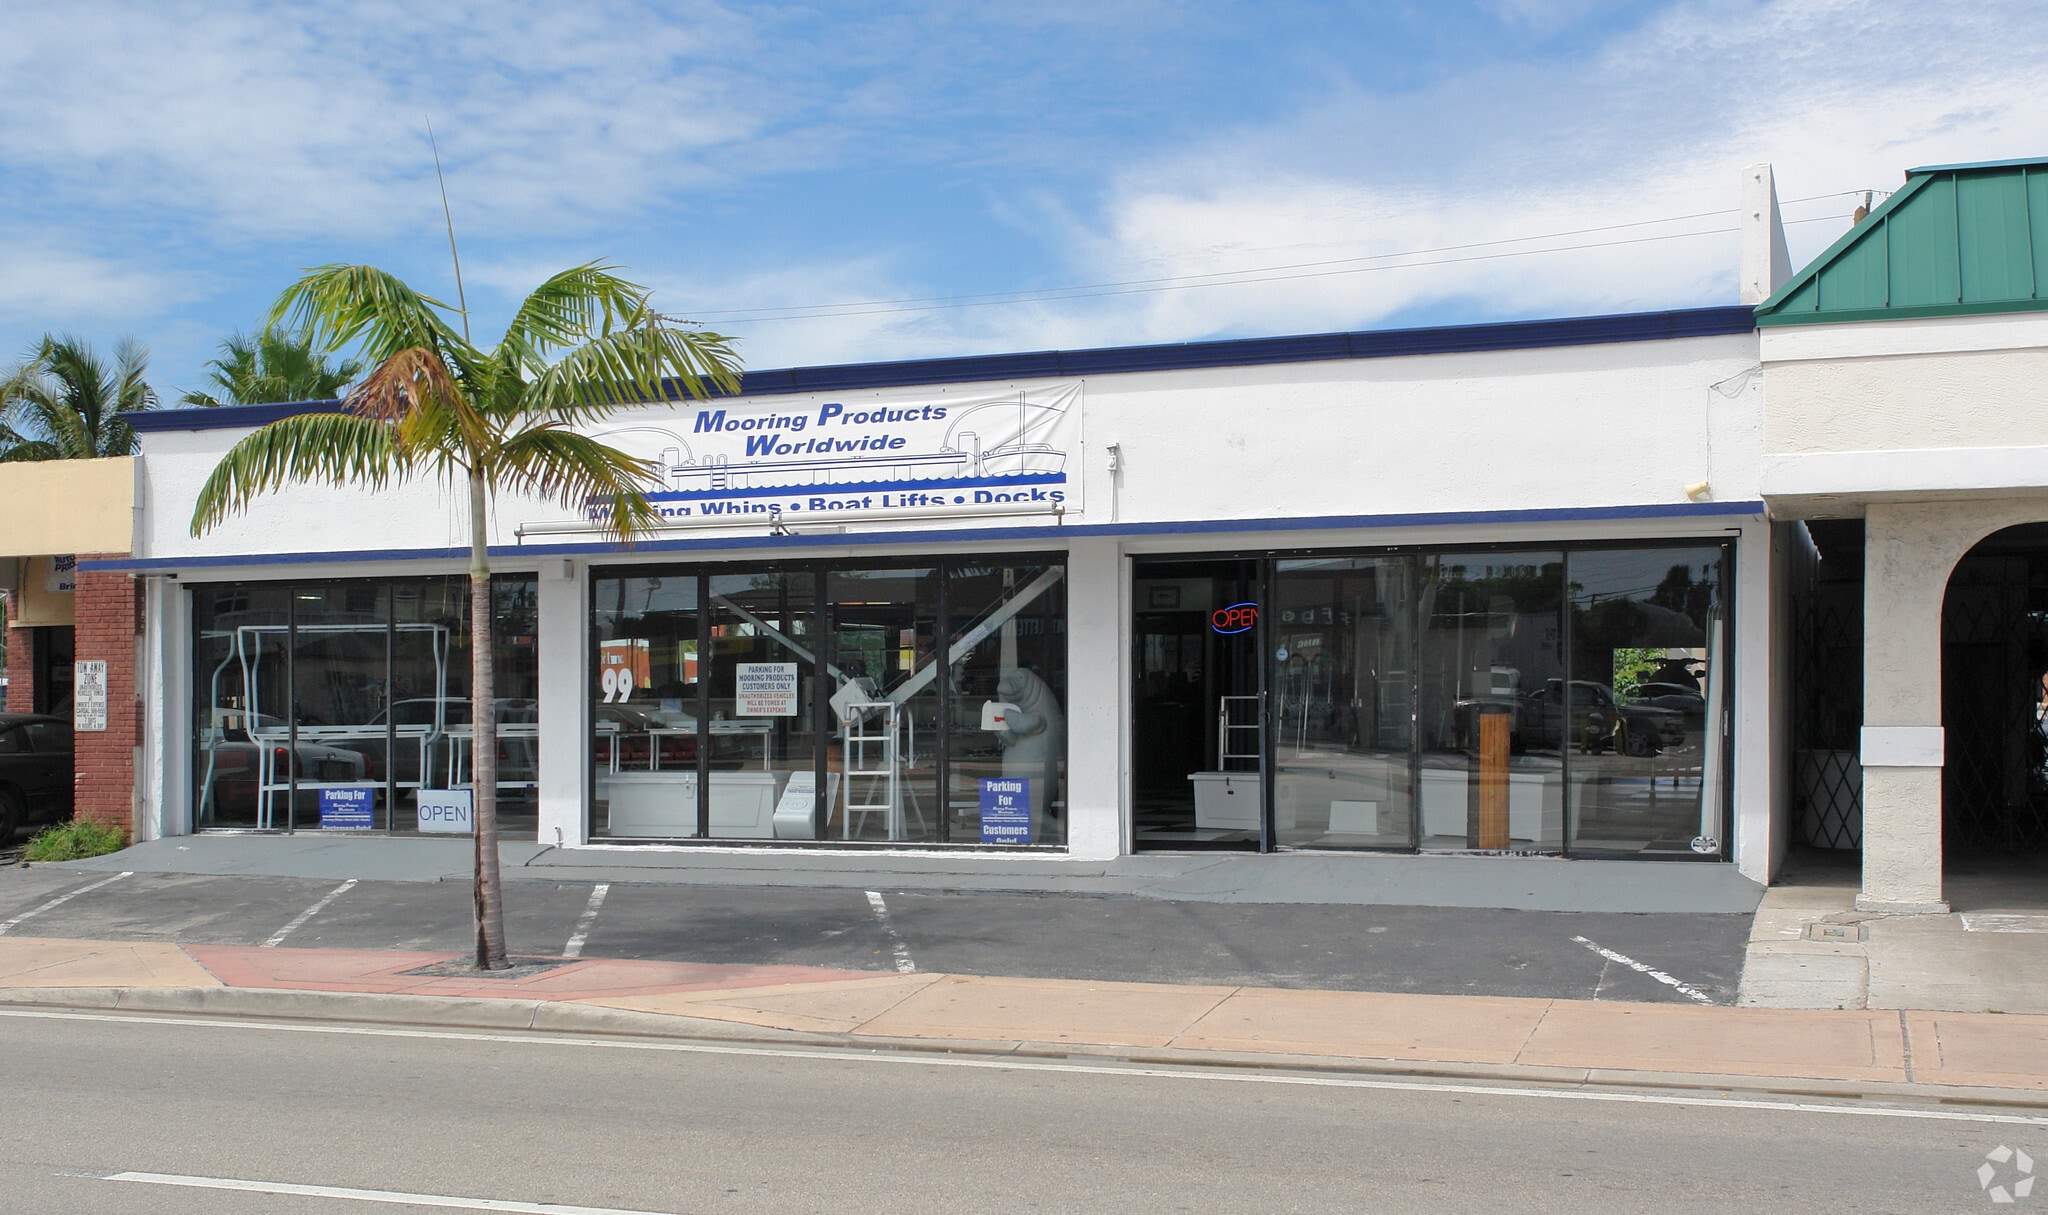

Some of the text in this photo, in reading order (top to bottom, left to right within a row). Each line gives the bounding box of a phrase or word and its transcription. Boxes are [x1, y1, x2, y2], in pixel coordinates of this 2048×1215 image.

[693, 402, 947, 433] Mooring Products
[745, 434, 906, 457] Worldwide
[809, 496, 872, 511] Boat
[883, 492, 945, 508] Lifts
[974, 487, 1065, 503] Docks
[55, 561, 75, 572] PRID
[77, 662, 104, 673] TOW AWAY
[748, 665, 785, 673] PARKING FOR
[84, 673, 98, 685] ZONE
[602, 668, 633, 703] 99
[742, 682, 791, 690] CUSTOMERS ONLY
[987, 781, 1022, 793] Parking
[325, 790, 366, 801] Parking For
[998, 794, 1013, 806] For
[419, 805, 466, 822] OPEN
[983, 825, 1028, 835] Customers
